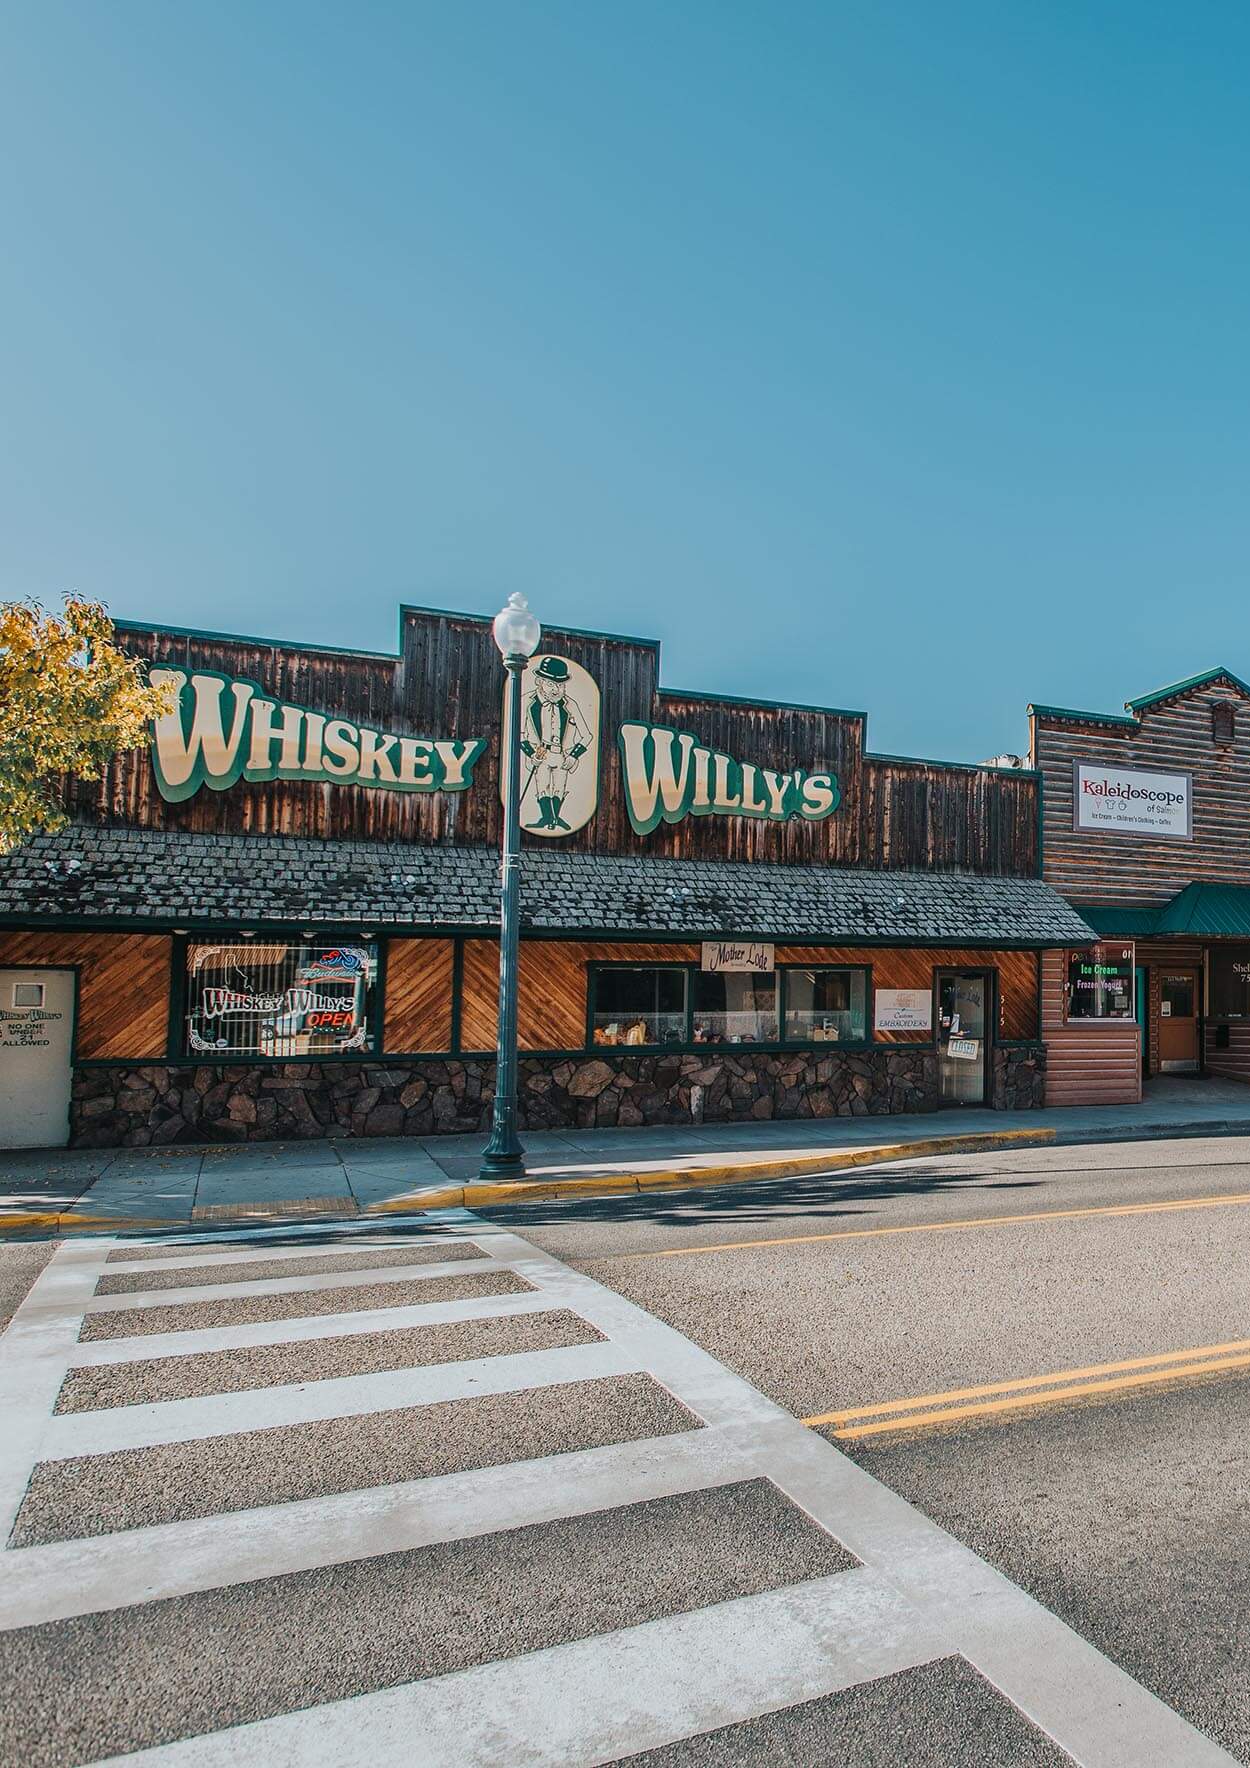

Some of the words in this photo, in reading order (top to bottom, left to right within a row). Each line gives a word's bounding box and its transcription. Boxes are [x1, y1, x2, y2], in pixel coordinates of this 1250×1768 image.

[150, 669, 477, 786] WHISKEY
[621, 724, 834, 822] WILLY'S
[1082, 779, 1184, 806] Kaleidoscope
[745, 943, 768, 970] Lode
[1081, 964, 1092, 974] Ice
[1094, 964, 1118, 975] Cream
[203, 988, 284, 1019] WHISKEY
[288, 988, 356, 1018] WILLY'S
[307, 1012, 355, 1026] OPEN
